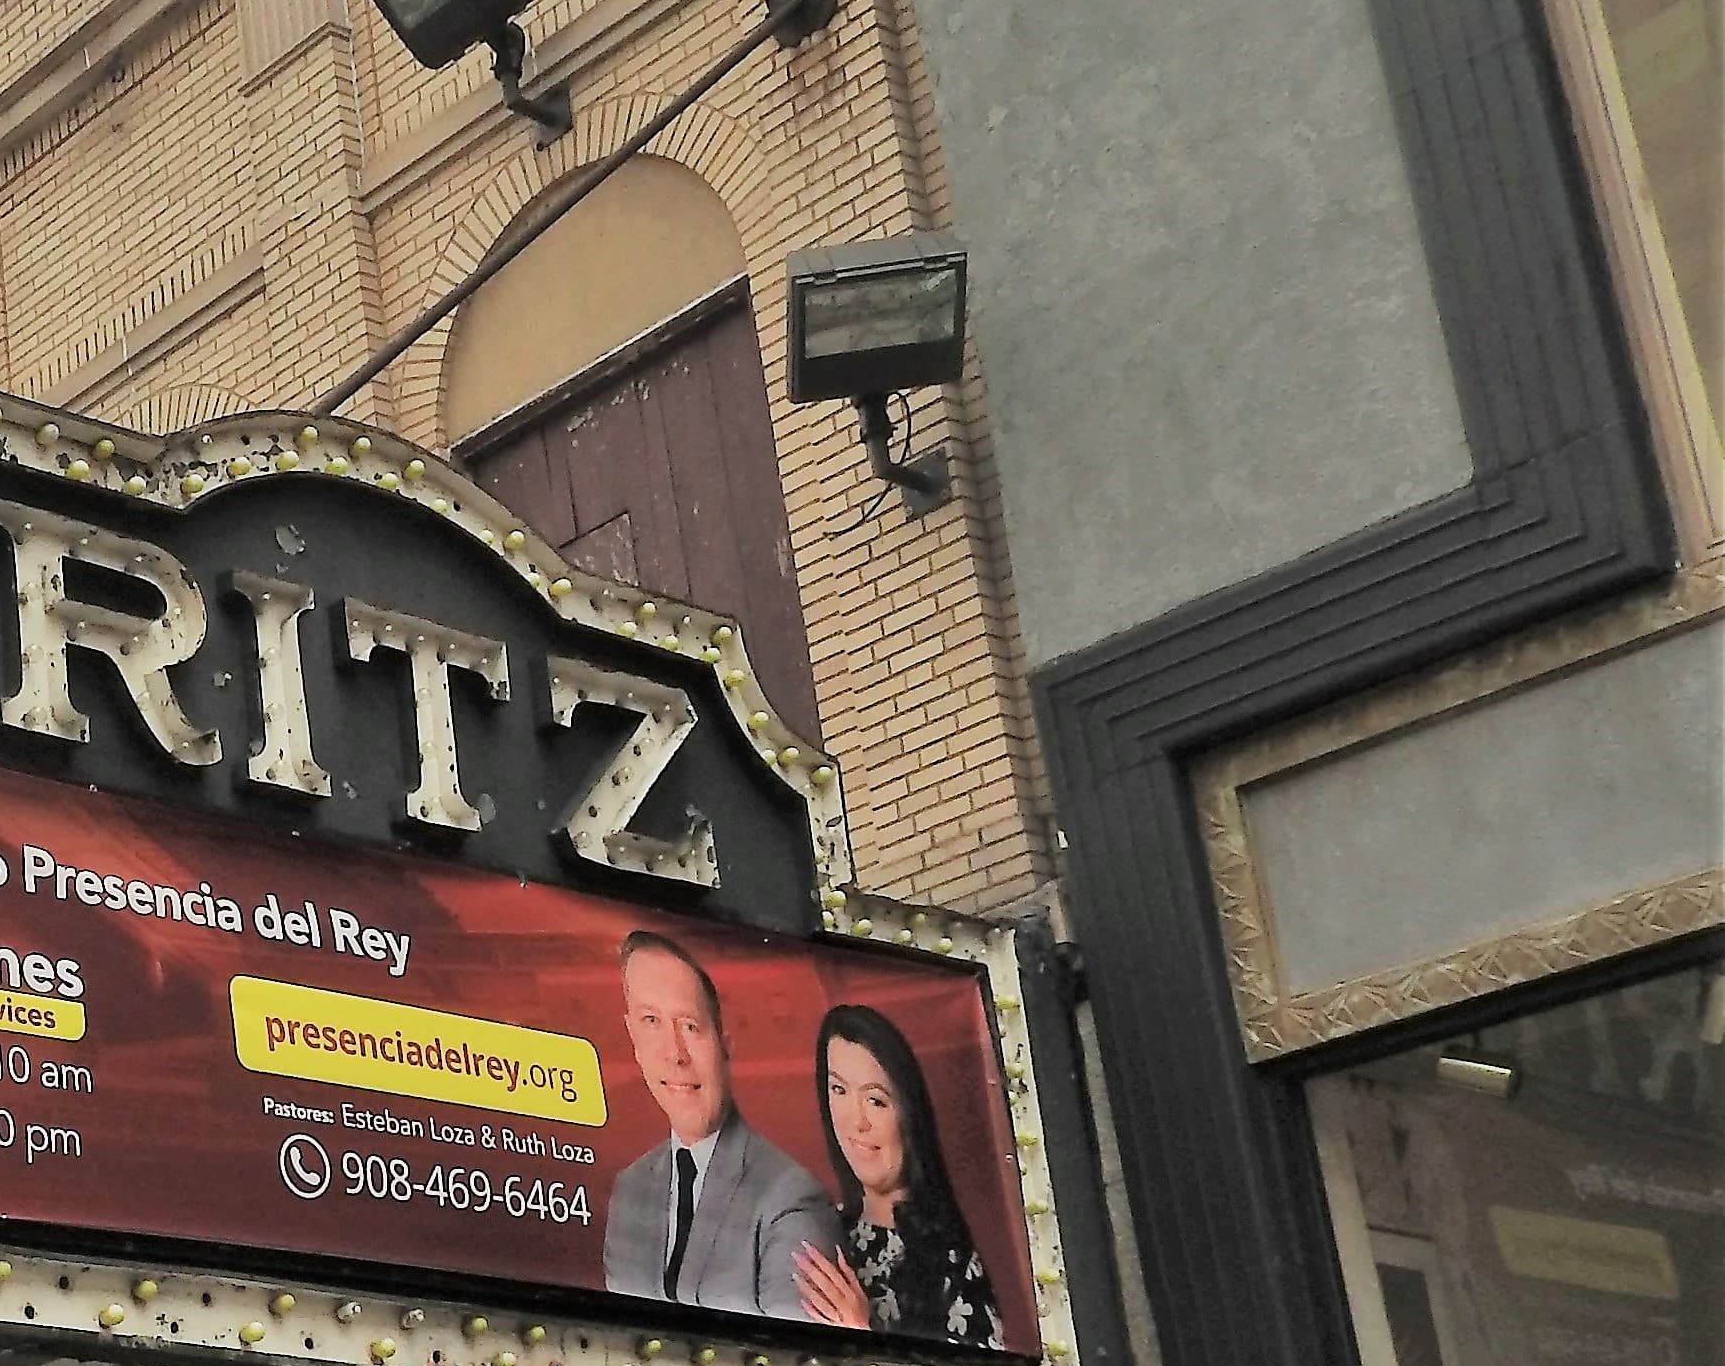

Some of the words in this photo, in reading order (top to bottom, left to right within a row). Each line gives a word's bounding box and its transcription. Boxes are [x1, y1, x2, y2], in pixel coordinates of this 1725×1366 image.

[23, 844, 242, 933] Presencia
[252, 893, 321, 948] del
[328, 907, 410, 977] Rey
[40, 1059, 94, 1094] am
[265, 1015, 579, 1103] presenciadelrey.org
[26, 1122, 81, 1164] pm
[263, 1096, 334, 1124] Pastores:
[340, 1103, 424, 1137] Esteban
[429, 1116, 475, 1147] Loza
[480, 1125, 498, 1149] &
[501, 1128, 546, 1157] Ruth
[551, 1137, 595, 1164] Loza
[341, 1151, 592, 1227] 908-469-6464
